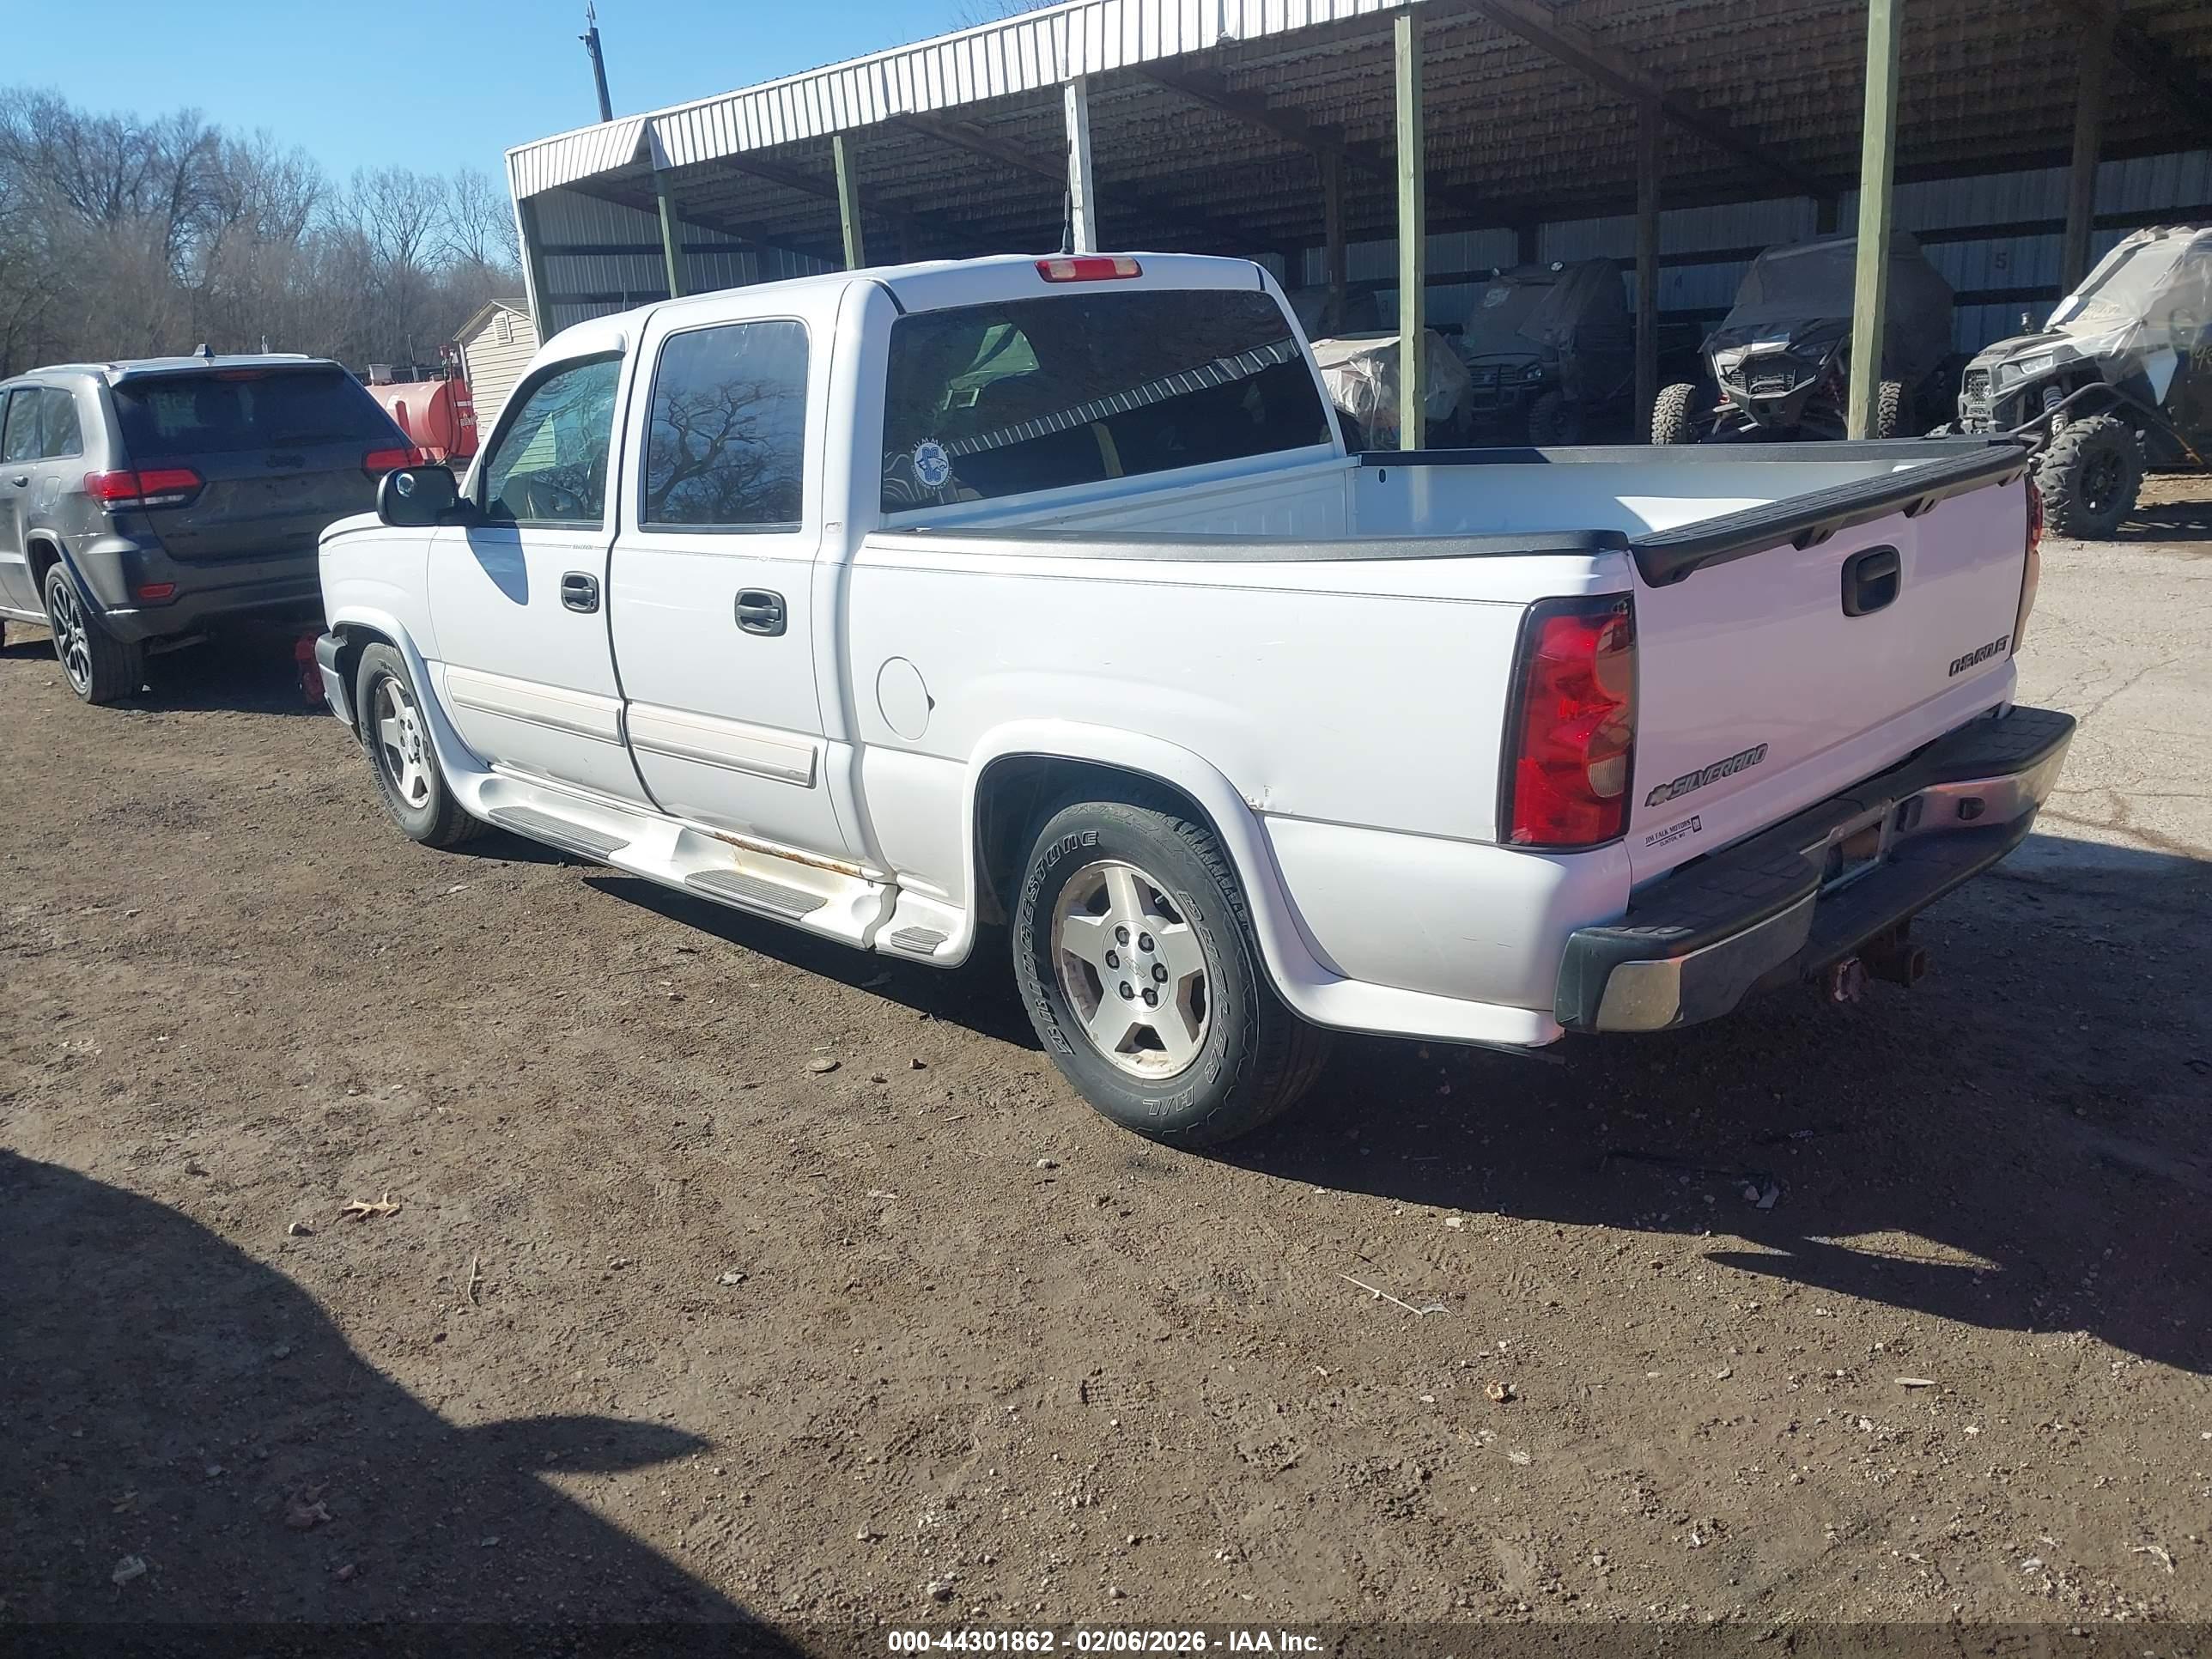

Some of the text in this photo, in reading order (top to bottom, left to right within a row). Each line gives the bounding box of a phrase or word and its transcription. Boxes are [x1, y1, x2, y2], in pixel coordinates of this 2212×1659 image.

[1996, 252, 2007, 269] 5
[910, 436, 951, 455] SUMMIT
[1670, 743, 1769, 799] SILVERADO
[1645, 820, 1692, 845] JIM FALK MOTORS
[1020, 830, 1100, 1055] BRIDGESTONE
[1142, 890, 1231, 1117] DUELER H/L
